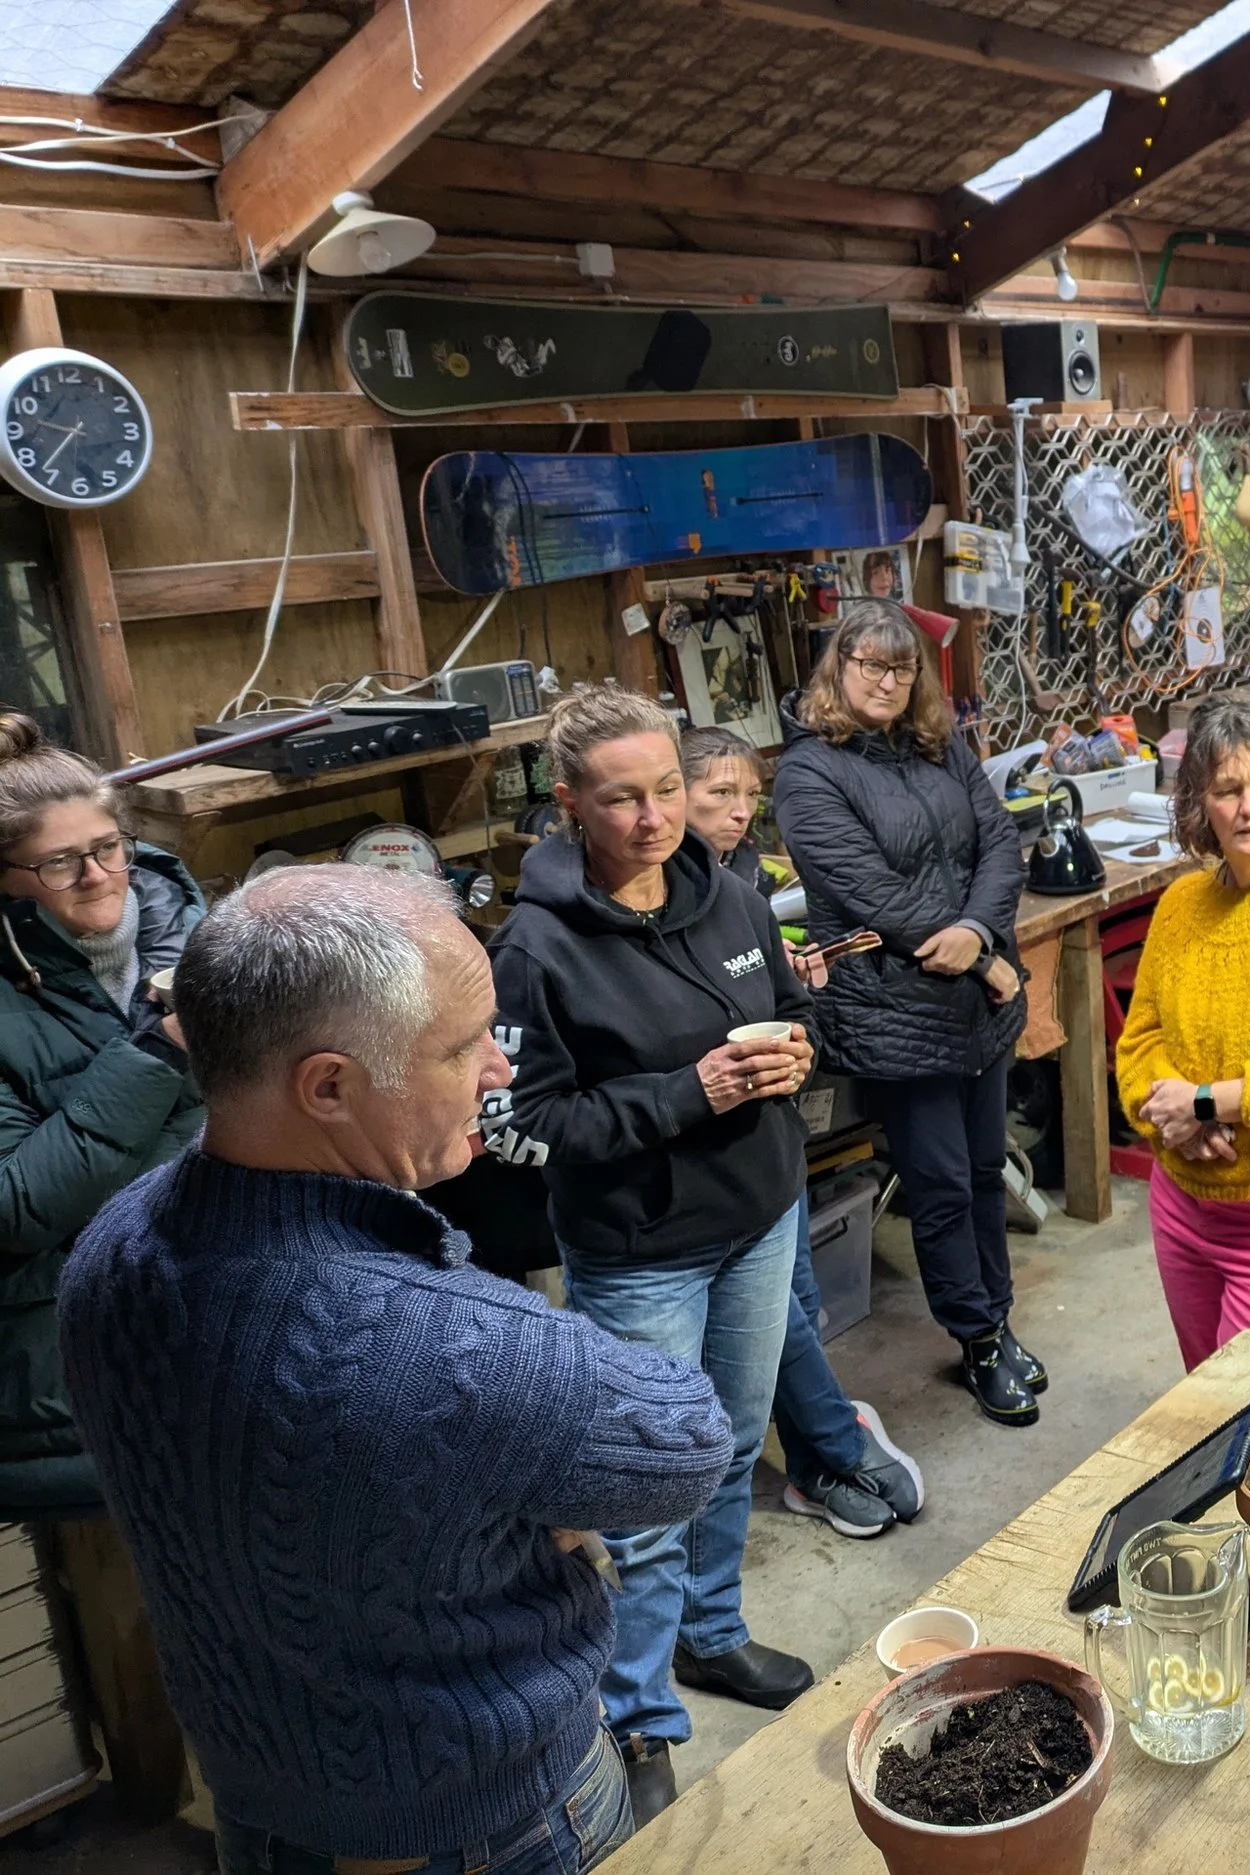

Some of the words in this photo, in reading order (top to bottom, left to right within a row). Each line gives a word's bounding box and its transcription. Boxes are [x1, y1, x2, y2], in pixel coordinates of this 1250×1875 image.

[32, 376, 51, 393] 11
[57, 367, 82, 384] 12
[95, 377, 104, 393] 1
[14, 396, 39, 415] 10
[114, 396, 130, 413] 2
[7, 421, 24, 441] 9
[122, 422, 140, 441] 3
[18, 447, 36, 467] 8
[116, 450, 134, 468] 4
[44, 468, 60, 486] 7
[102, 470, 118, 487] 5
[71, 477, 90, 496] 6
[481, 1025, 549, 1167] RGLAN
